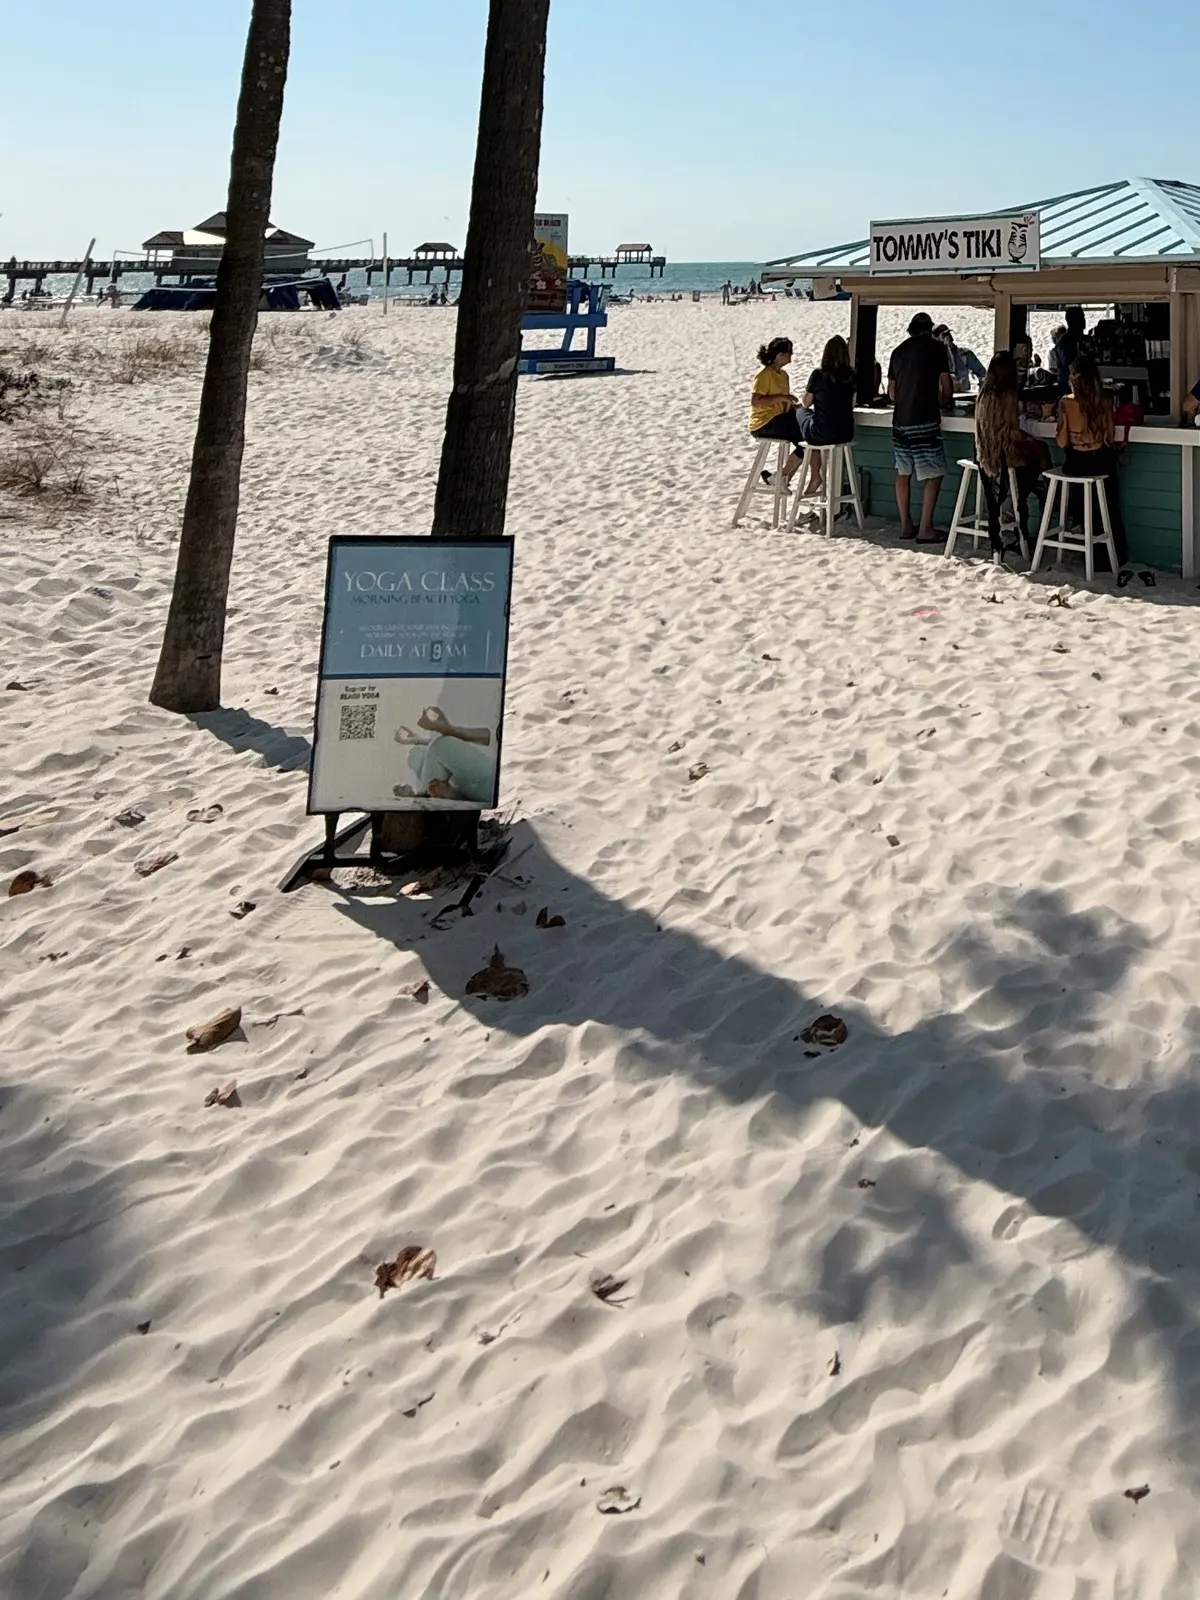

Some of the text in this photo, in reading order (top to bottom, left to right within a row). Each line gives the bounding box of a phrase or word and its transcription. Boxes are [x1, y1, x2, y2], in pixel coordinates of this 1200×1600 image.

[873, 229, 1001, 262] TOMMY'S TIKI
[344, 571, 495, 592] YOGA CLASS
[350, 594, 480, 604] MORNING BEACH YOGA
[360, 643, 404, 658] DAILY
[409, 643, 427, 657] AT
